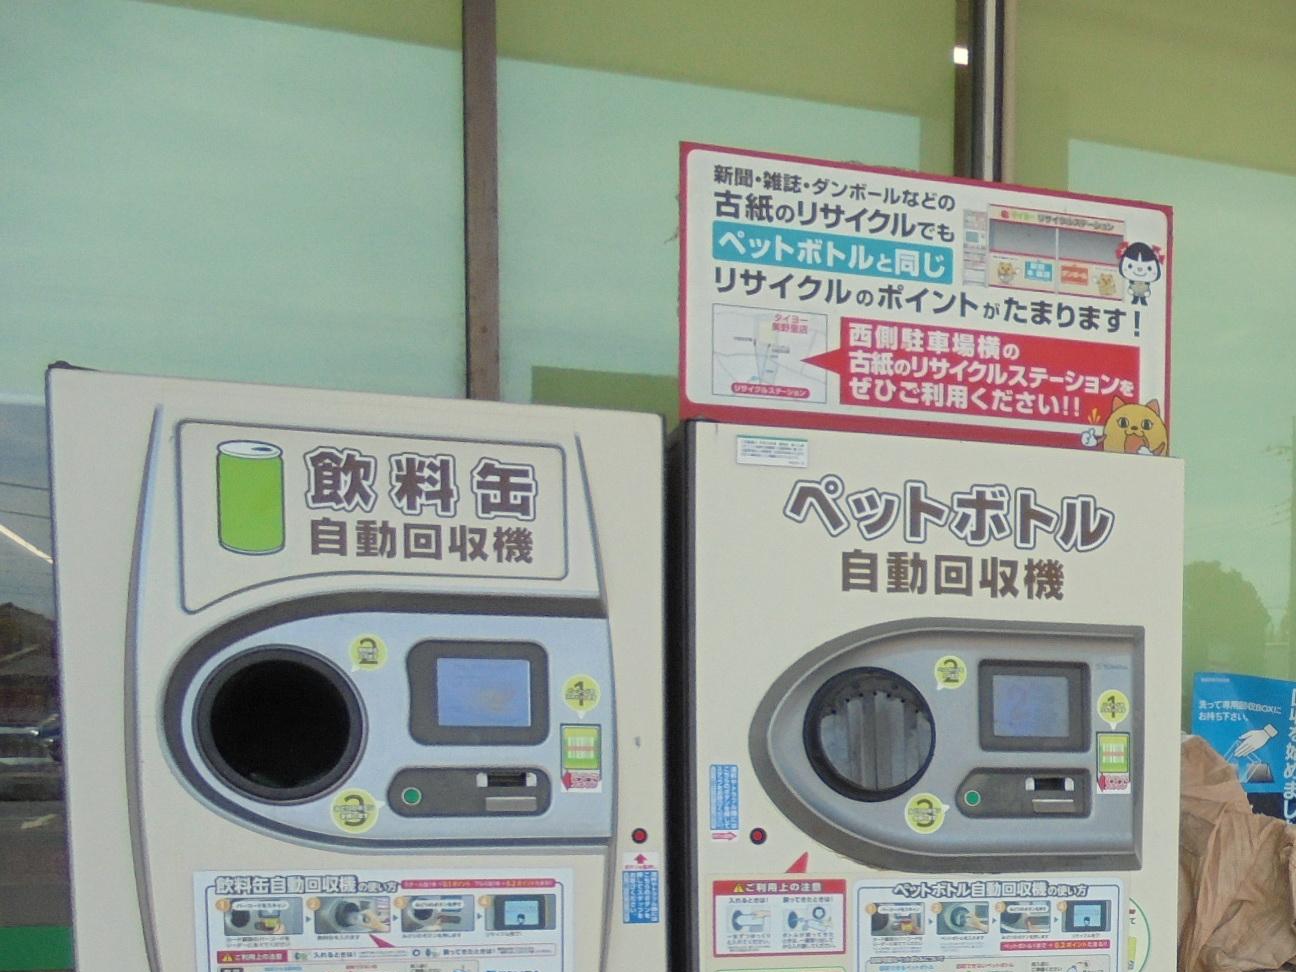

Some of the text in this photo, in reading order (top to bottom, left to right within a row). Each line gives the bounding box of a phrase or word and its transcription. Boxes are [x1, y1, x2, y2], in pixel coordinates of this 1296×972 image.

[714, 164, 955, 212] 新聞・雑誌・ダンボールなどの
[715, 191, 954, 242] 古紙のリサイクルでも
[718, 229, 947, 277] ペットボトルと同じ
[715, 267, 1141, 336] リサイクルのポイントがたまります！
[849, 323, 1020, 359] 西側駐車場横の
[849, 350, 1135, 396] 古紙のリサイクルステーションを
[305, 447, 538, 520] 飲料缶
[784, 475, 1115, 552] ペットボトル
[310, 518, 534, 563] 自動回収機
[842, 549, 1065, 600] 自動回収機
[215, 875, 399, 894] 飲料缶自動回収機の使い方
[746, 882, 822, 892] ご利用上の注意
[892, 880, 1089, 898] ペットボトル自動回収機の使い方
